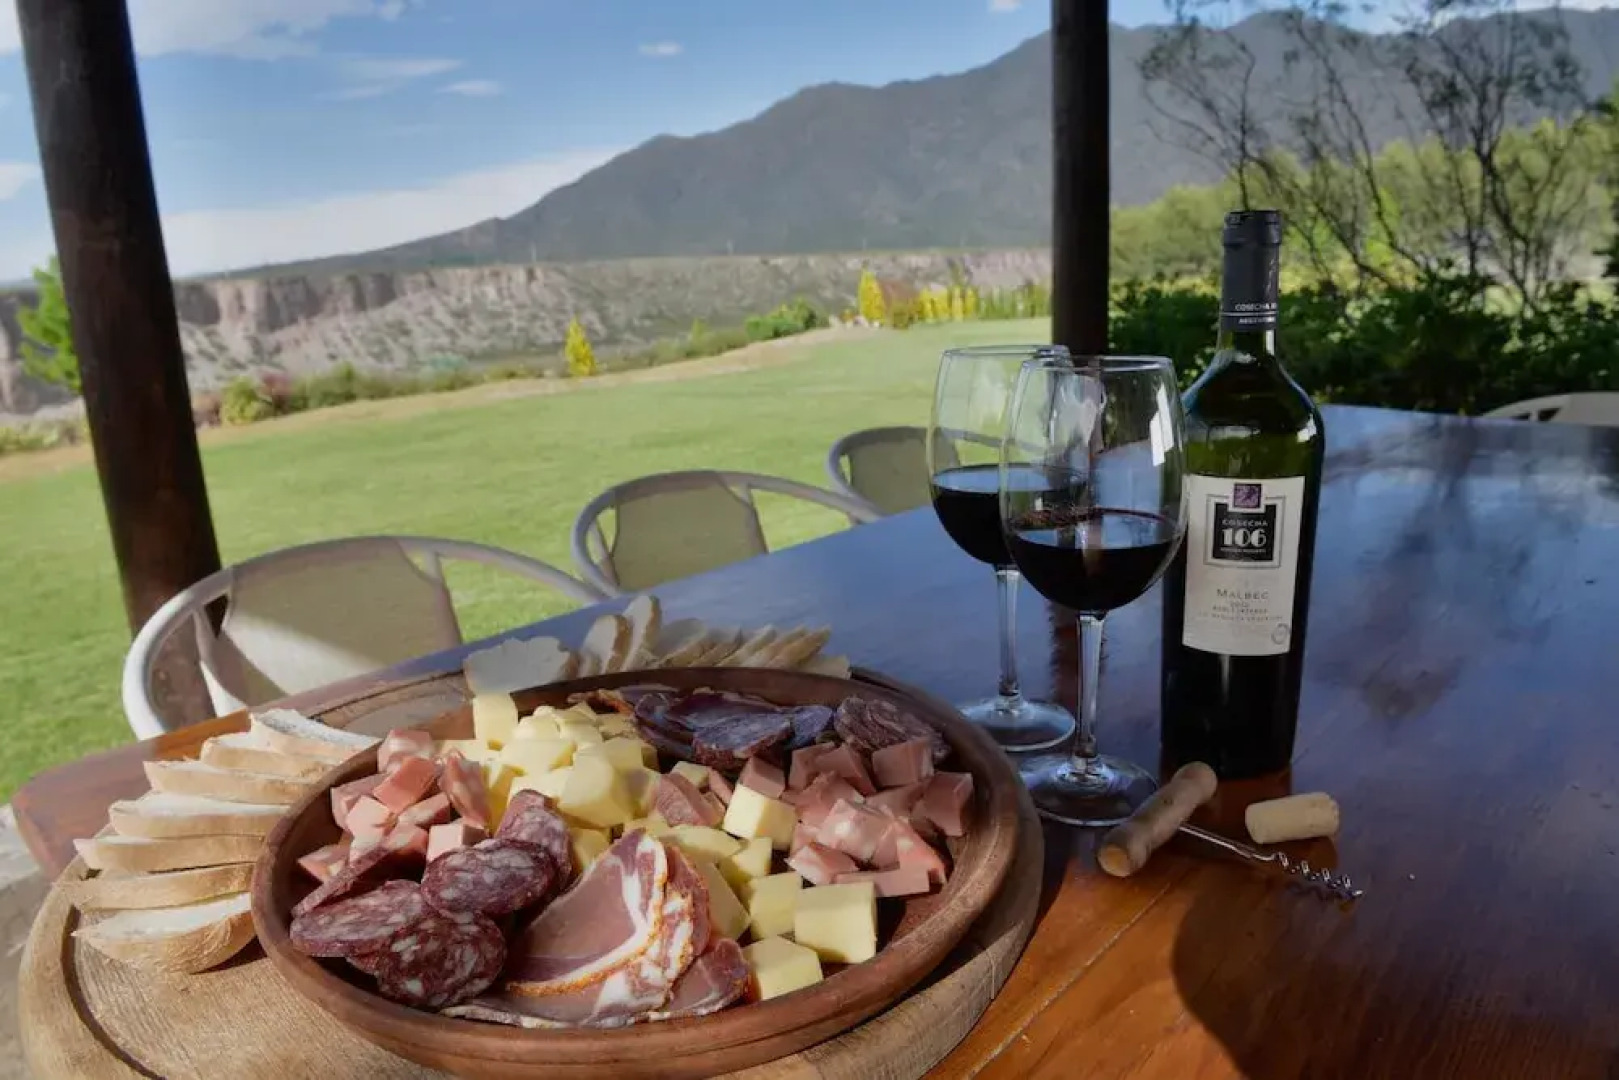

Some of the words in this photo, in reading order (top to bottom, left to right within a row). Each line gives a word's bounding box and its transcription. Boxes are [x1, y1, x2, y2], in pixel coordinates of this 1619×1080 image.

[1221, 519, 1268, 527] COSECHA
[1221, 528, 1267, 548] 106
[1217, 588, 1269, 600] MALBEC
